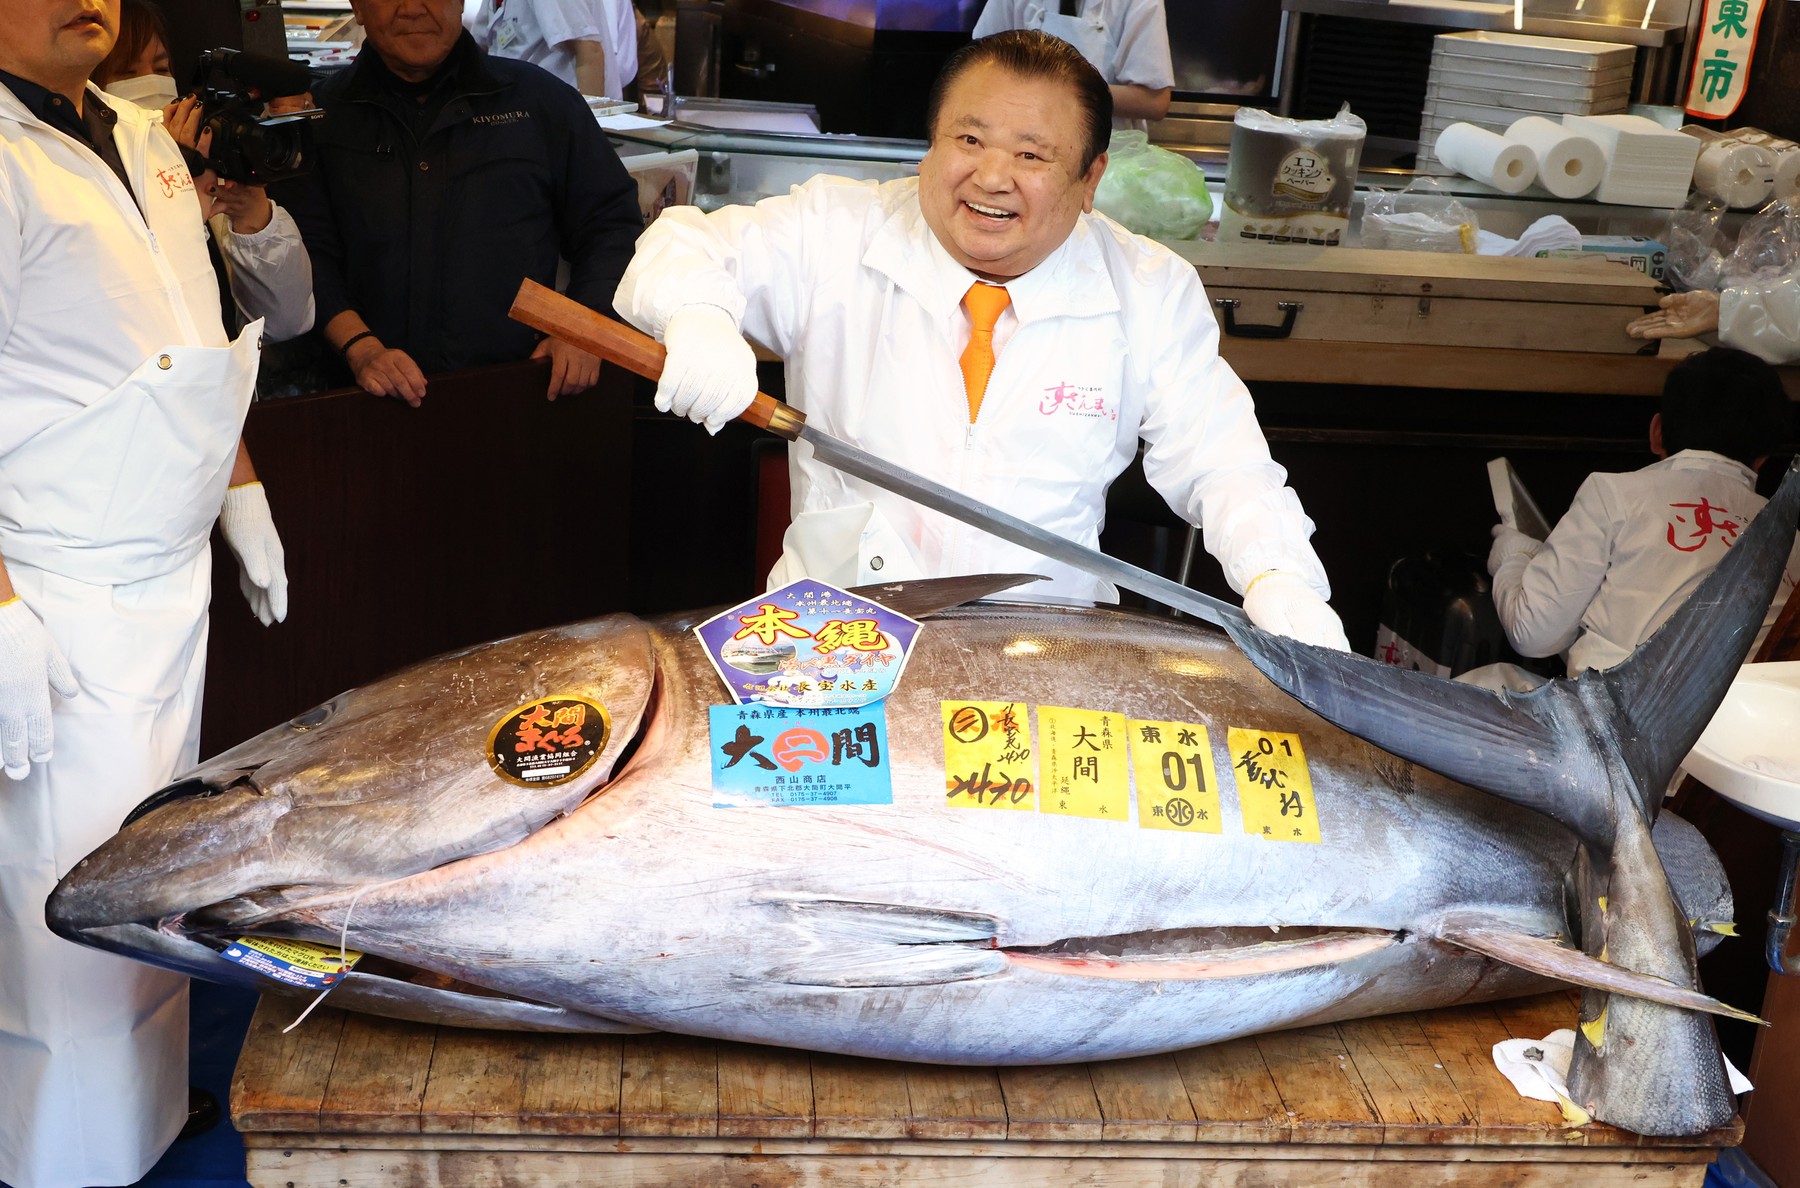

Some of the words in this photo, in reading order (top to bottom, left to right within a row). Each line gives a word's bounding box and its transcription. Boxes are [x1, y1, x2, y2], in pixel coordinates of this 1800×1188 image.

[472, 111, 530, 124] KIYOMURA
[1293, 156, 1316, 168] エコ
[1283, 165, 1324, 179] クッキング
[1286, 178, 1316, 186] ペーパー
[786, 591, 832, 599] 大間港
[794, 599, 853, 607] 本州最北端
[734, 603, 891, 654] 本縄
[795, 678, 879, 692] 長宝水産
[519, 703, 586, 730] 大間
[736, 709, 788, 720] 青森県産
[795, 707, 860, 717] 本州最北端
[514, 725, 584, 753] まぐろ
[1100, 715, 1113, 750] 青森県
[1258, 737, 1293, 757] 01
[1072, 725, 1102, 784] 大間
[1161, 751, 1207, 793] 01
[775, 774, 827, 785] 西山商店
[1060, 776, 1071, 796] 延縄
